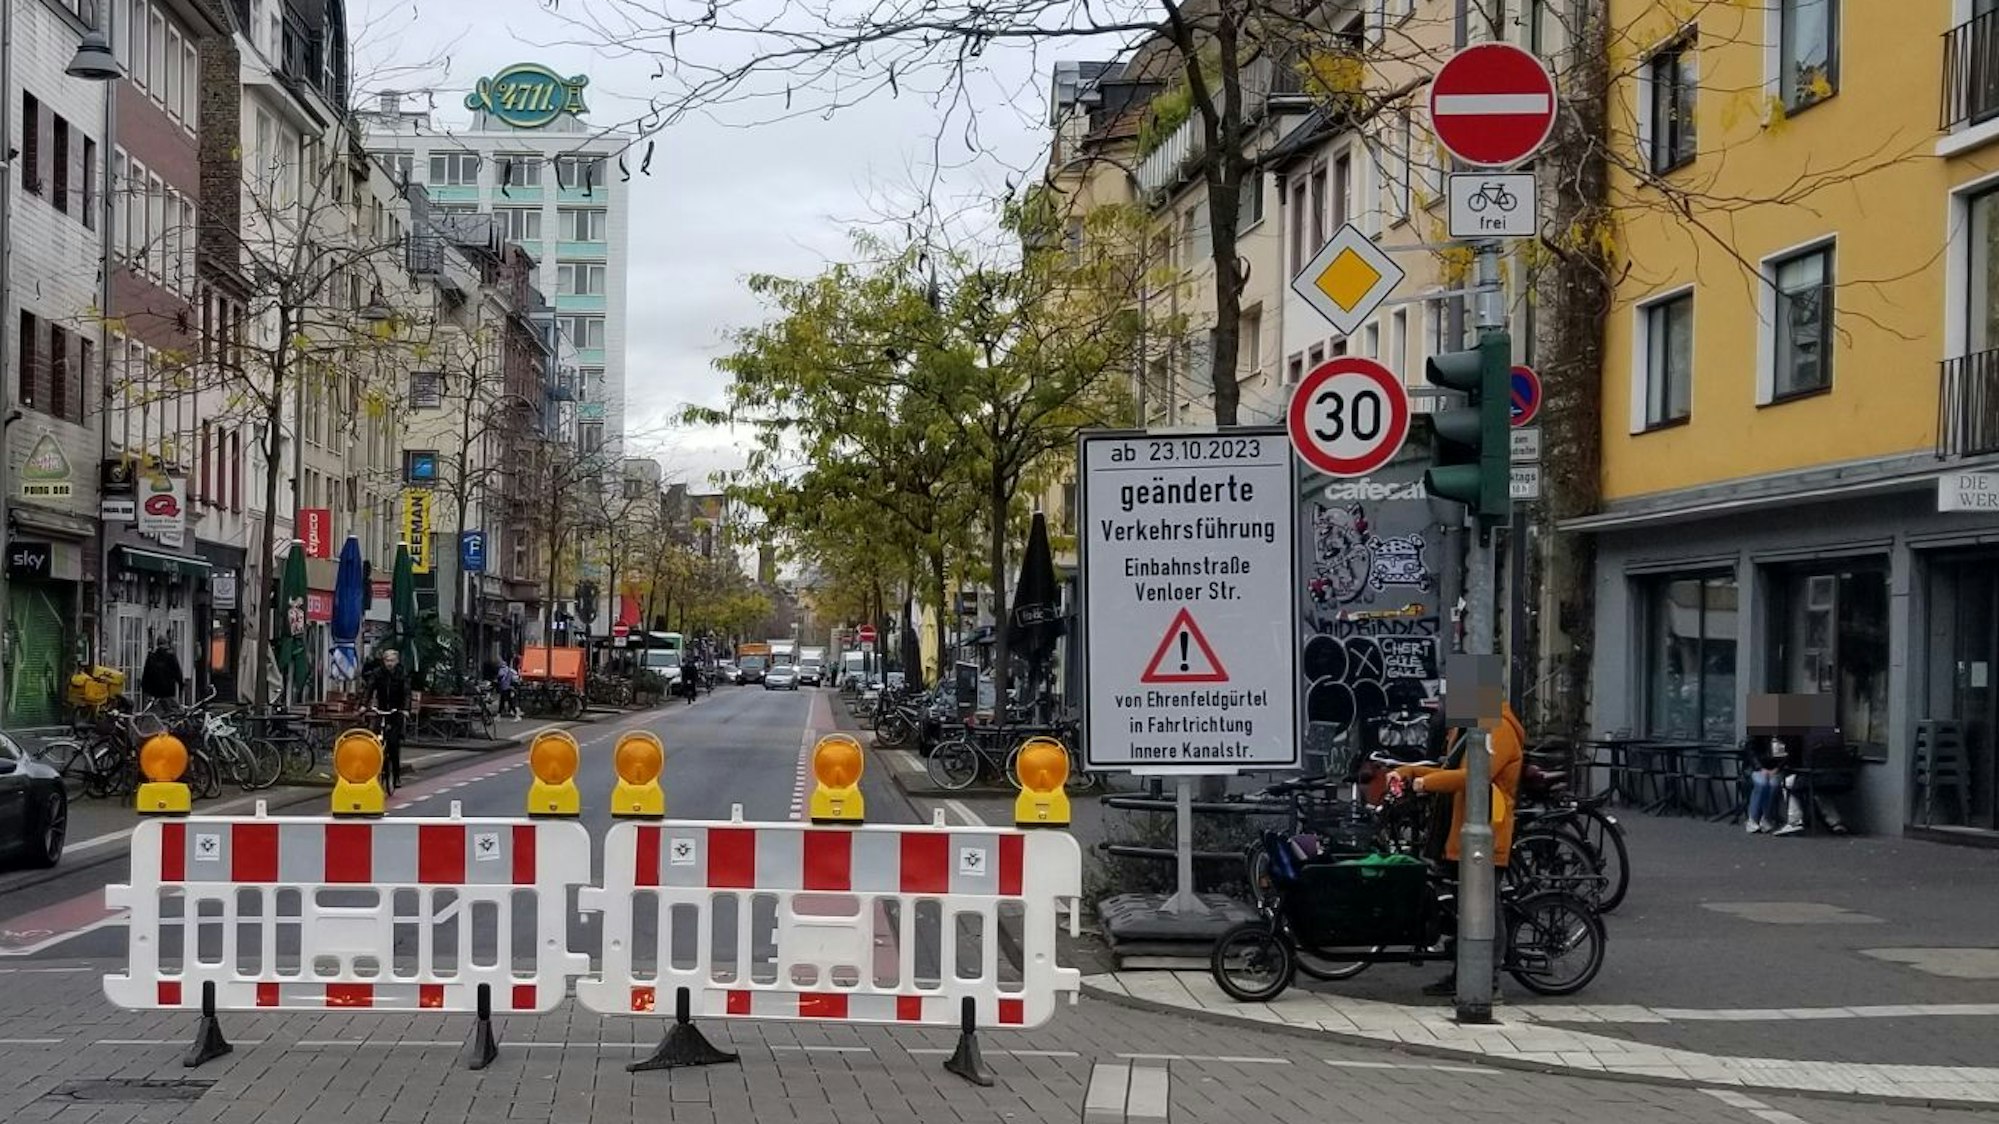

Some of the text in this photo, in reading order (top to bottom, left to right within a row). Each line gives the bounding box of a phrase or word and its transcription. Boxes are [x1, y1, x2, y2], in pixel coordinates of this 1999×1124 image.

[1480, 216, 1506, 230] frei
[1314, 390, 1380, 442] 30
[1111, 439, 1261, 462] ab 23.10.2023
[1960, 475, 1988, 490] DIE
[1121, 475, 1254, 512] geänderte
[1960, 493, 1999, 507] WER
[306, 512, 320, 557] tipico
[408, 496, 424, 567] ZEEMAN
[1101, 517, 1275, 543] Verkehrsführung
[13, 550, 45, 570] sky
[1125, 556, 1251, 577] Einbahnstraße
[1135, 581, 1241, 601] Venloer Str.
[1115, 689, 1268, 710] von Ehrenfeldgürtel
[1130, 716, 1253, 736] in Fahrtrichtung
[1130, 741, 1254, 758] Innere Kanalstr.
